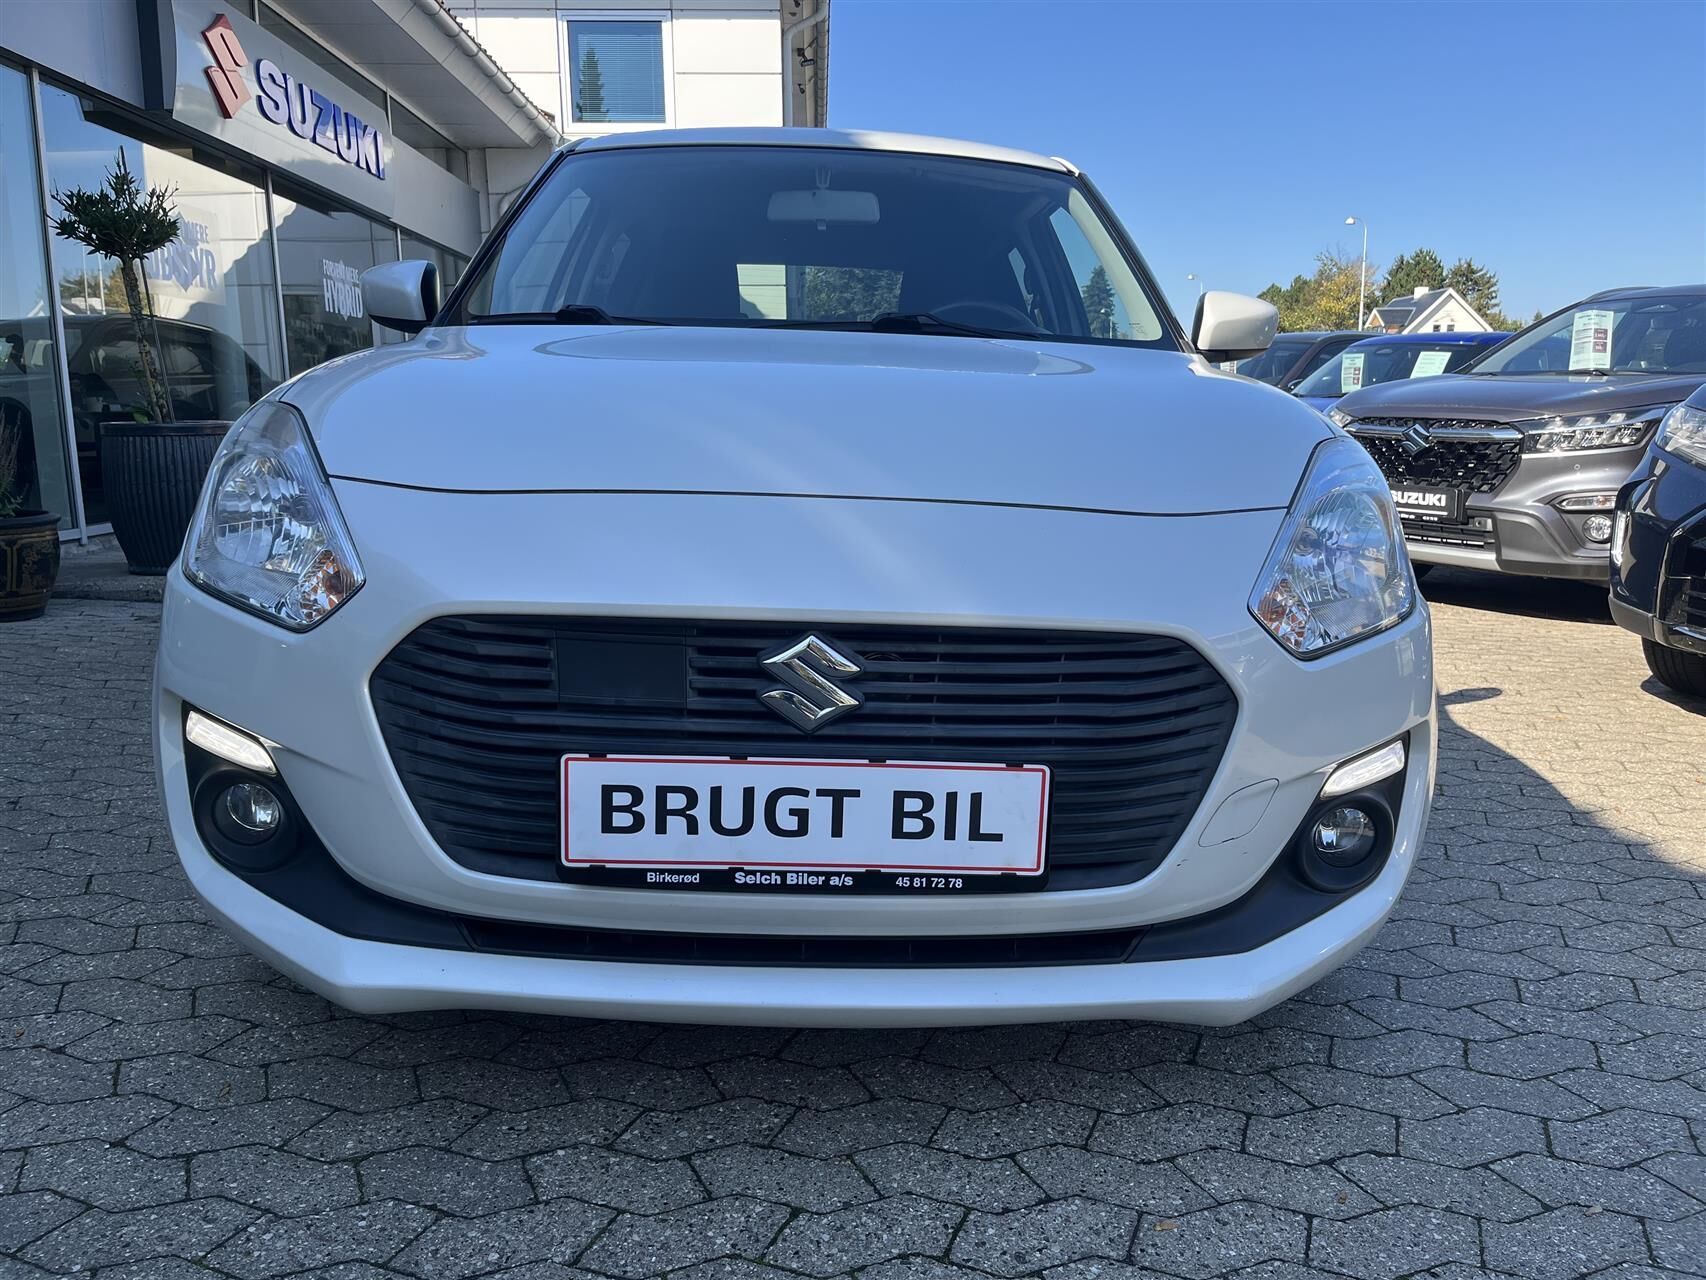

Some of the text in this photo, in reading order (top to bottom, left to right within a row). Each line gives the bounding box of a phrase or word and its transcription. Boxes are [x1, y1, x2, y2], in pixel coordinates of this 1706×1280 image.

[256, 59, 386, 180] SUZUKI
[323, 278, 364, 319] HYBRID
[600, 783, 1004, 843] BRUGT BIL
[646, 871, 700, 884] Birkerød
[734, 871, 854, 887] Selch Biler a/s
[895, 876, 963, 889] 45 81 72 78
